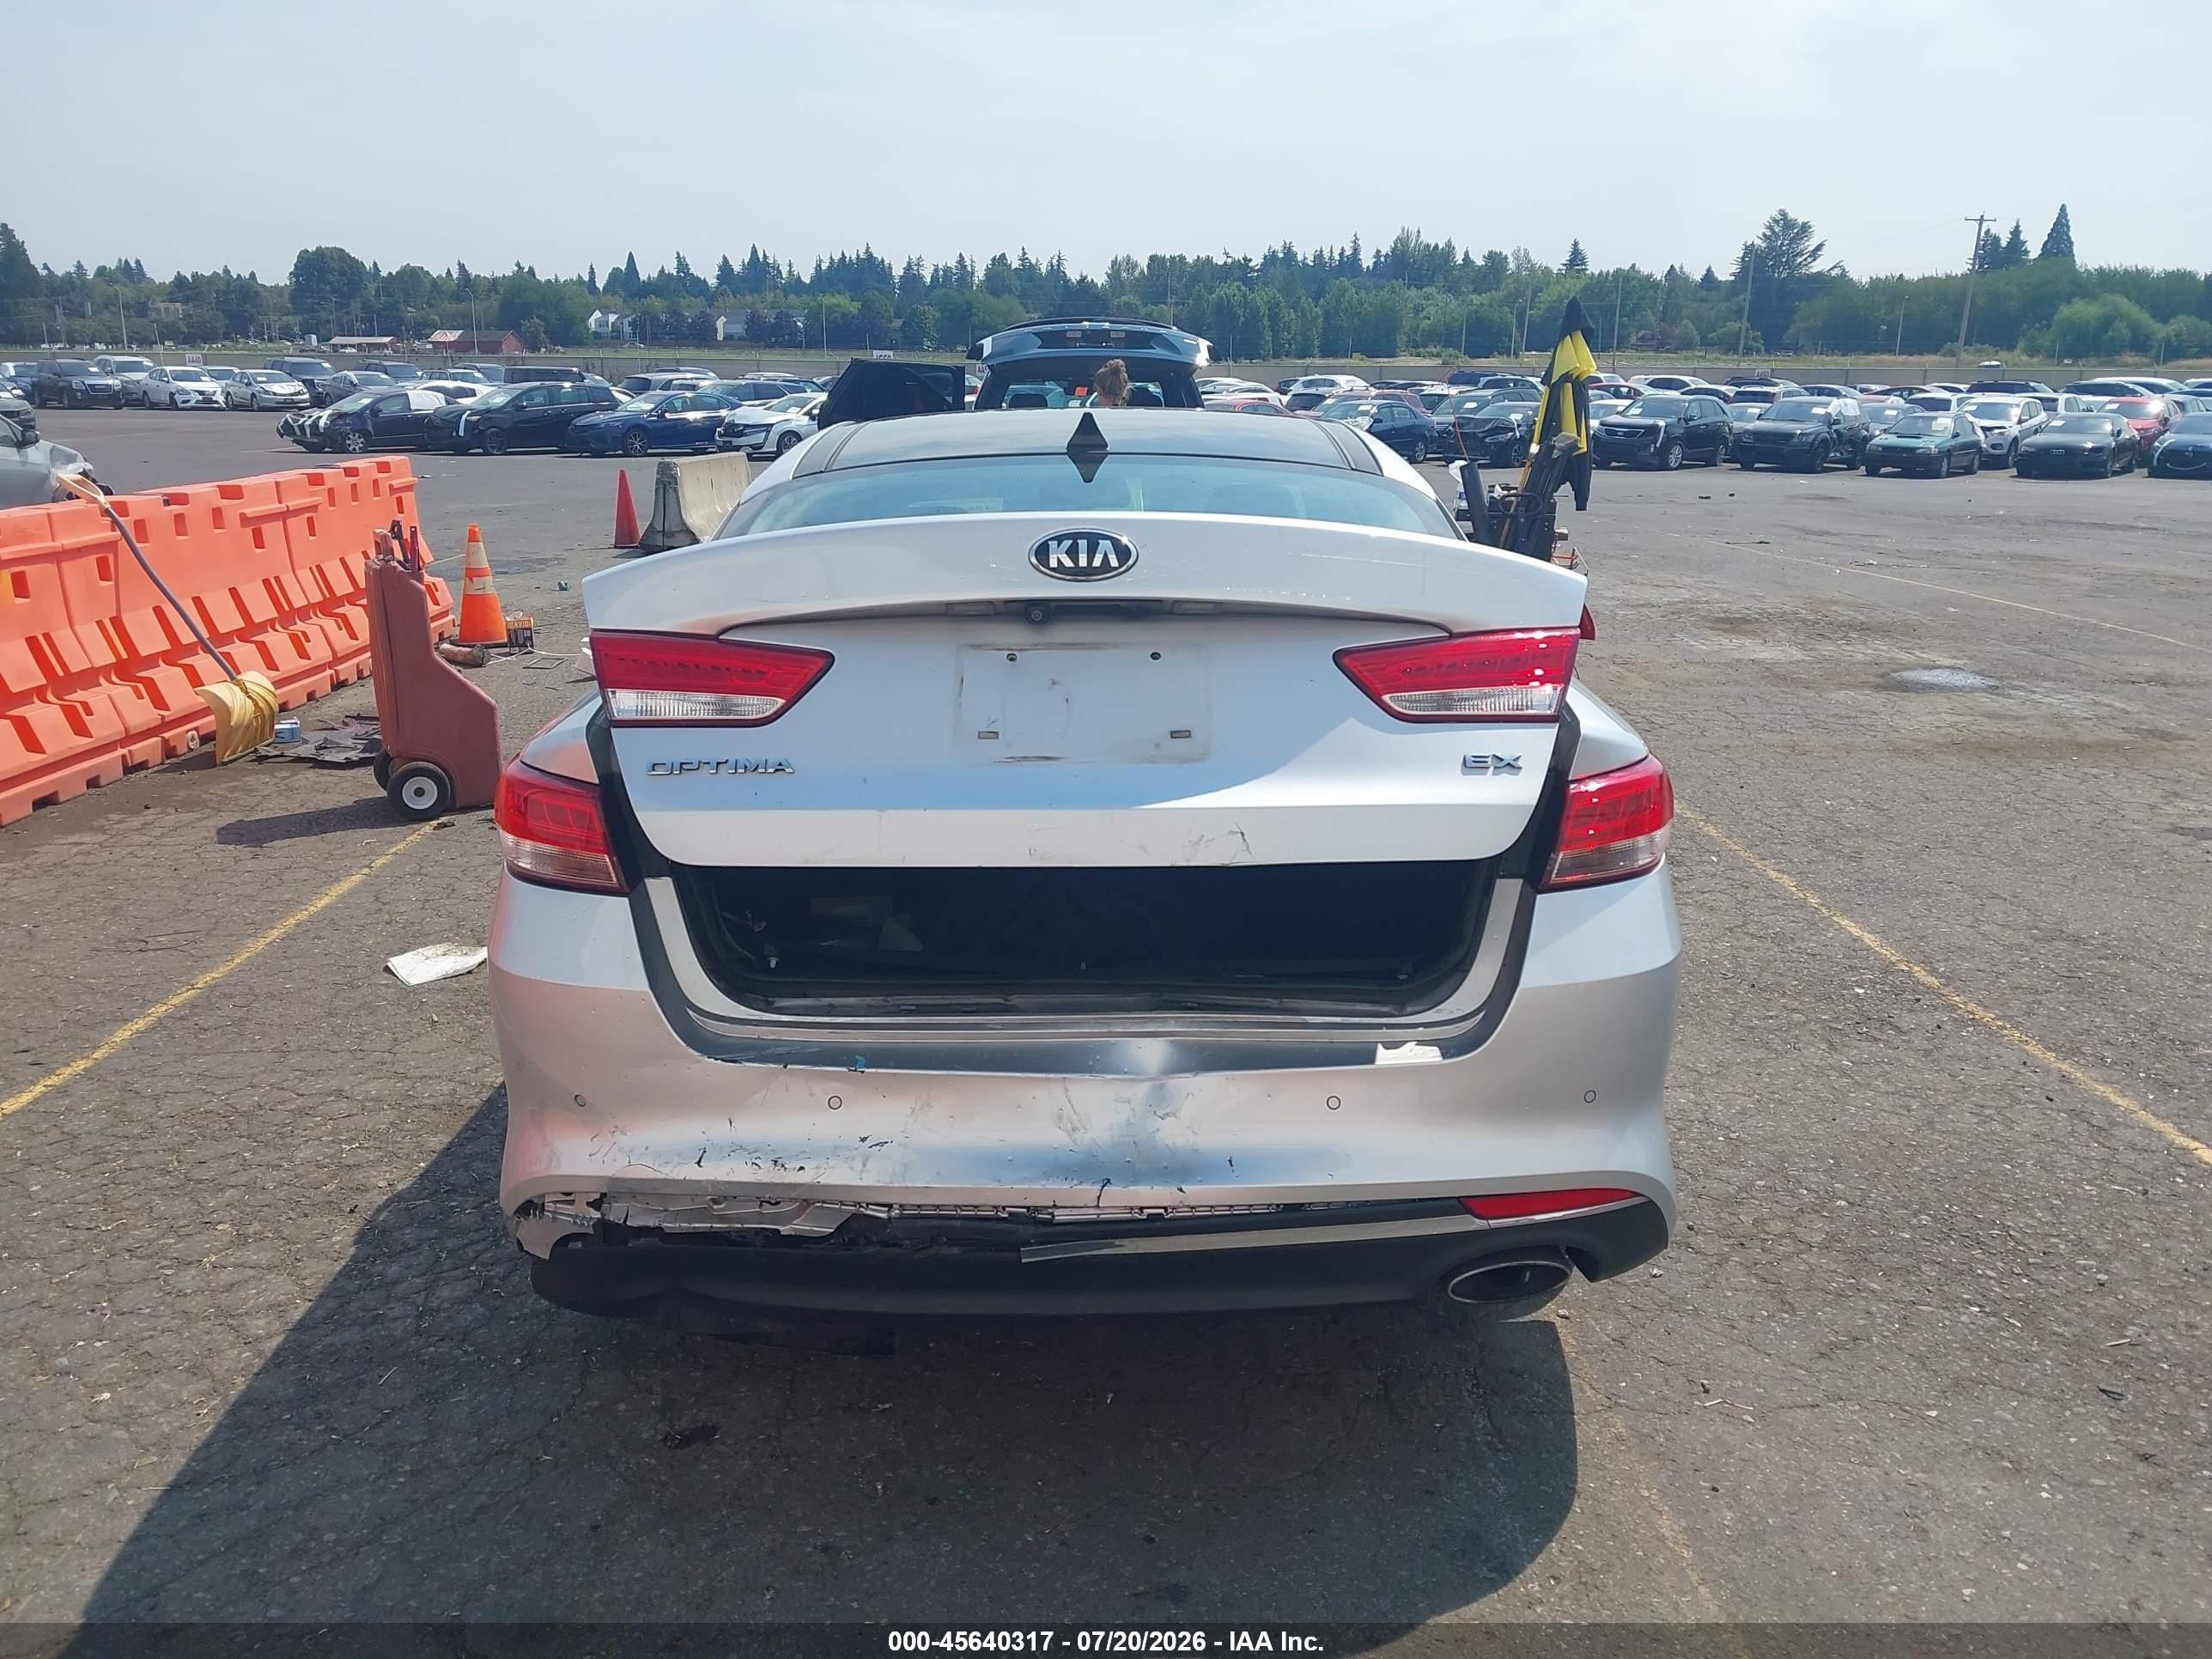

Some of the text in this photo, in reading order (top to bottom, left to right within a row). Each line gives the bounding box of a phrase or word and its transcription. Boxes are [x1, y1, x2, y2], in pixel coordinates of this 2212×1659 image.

[1048, 539, 1120, 568] KIA
[647, 757, 795, 775] OPTIMA
[1461, 753, 1522, 776] EX
